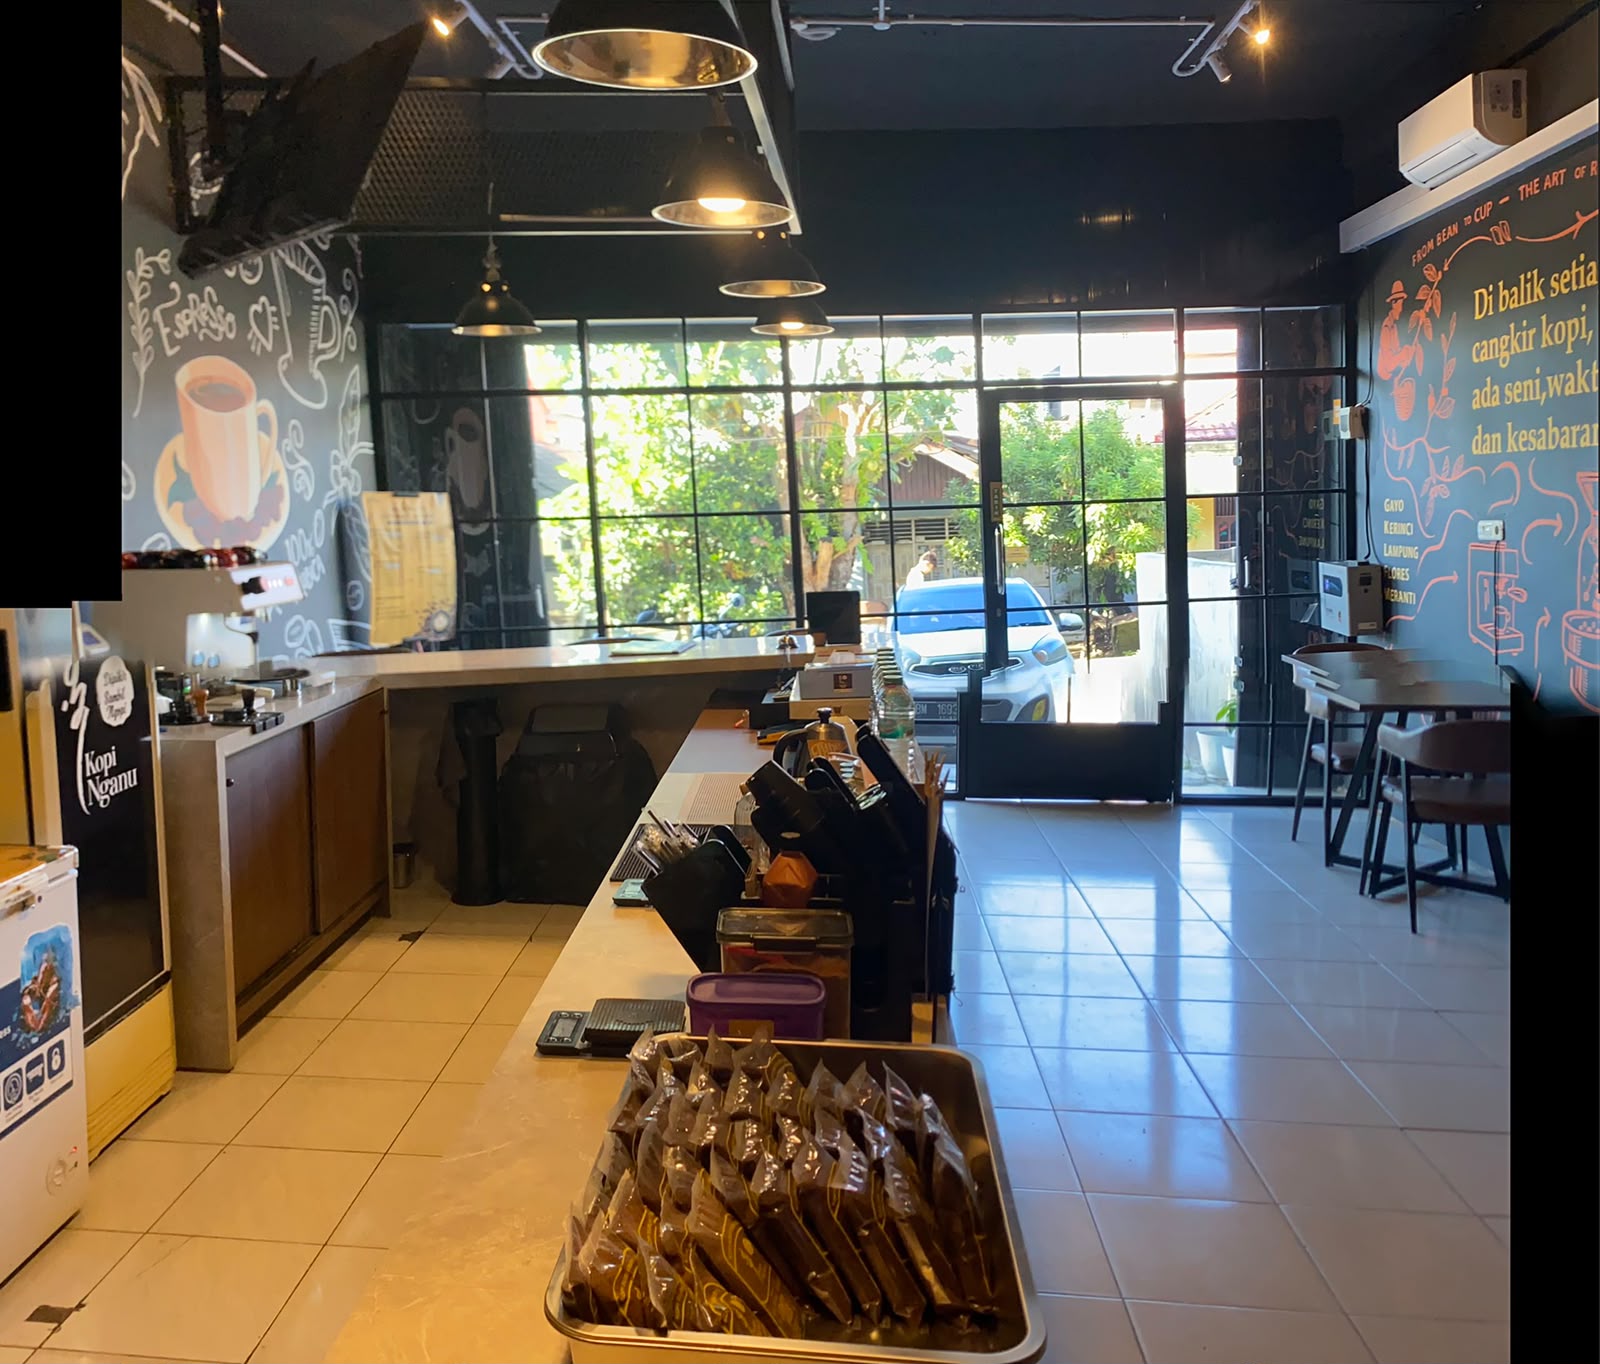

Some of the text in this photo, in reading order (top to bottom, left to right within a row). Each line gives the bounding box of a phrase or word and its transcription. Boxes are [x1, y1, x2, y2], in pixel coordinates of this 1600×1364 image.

[1412, 239, 1435, 267] FROM
[1436, 222, 1459, 246] BEAN
[1474, 201, 1493, 222] CUP
[1518, 178, 1541, 200] THE
[1544, 169, 1567, 190] ART
[1574, 165, 1586, 179] OF
[1474, 253, 1598, 320] Di balik setia
[1472, 303, 1594, 369] cangkir kopi,
[1472, 376, 1501, 410] ada
[1472, 424, 1502, 455] dan
[1383, 498, 1404, 513] GAYO
[1383, 520, 1414, 535] KERINCI
[1383, 543, 1419, 559] LAMPUNG
[84, 745, 117, 777] Kopi
[87, 767, 138, 808] Nganu
